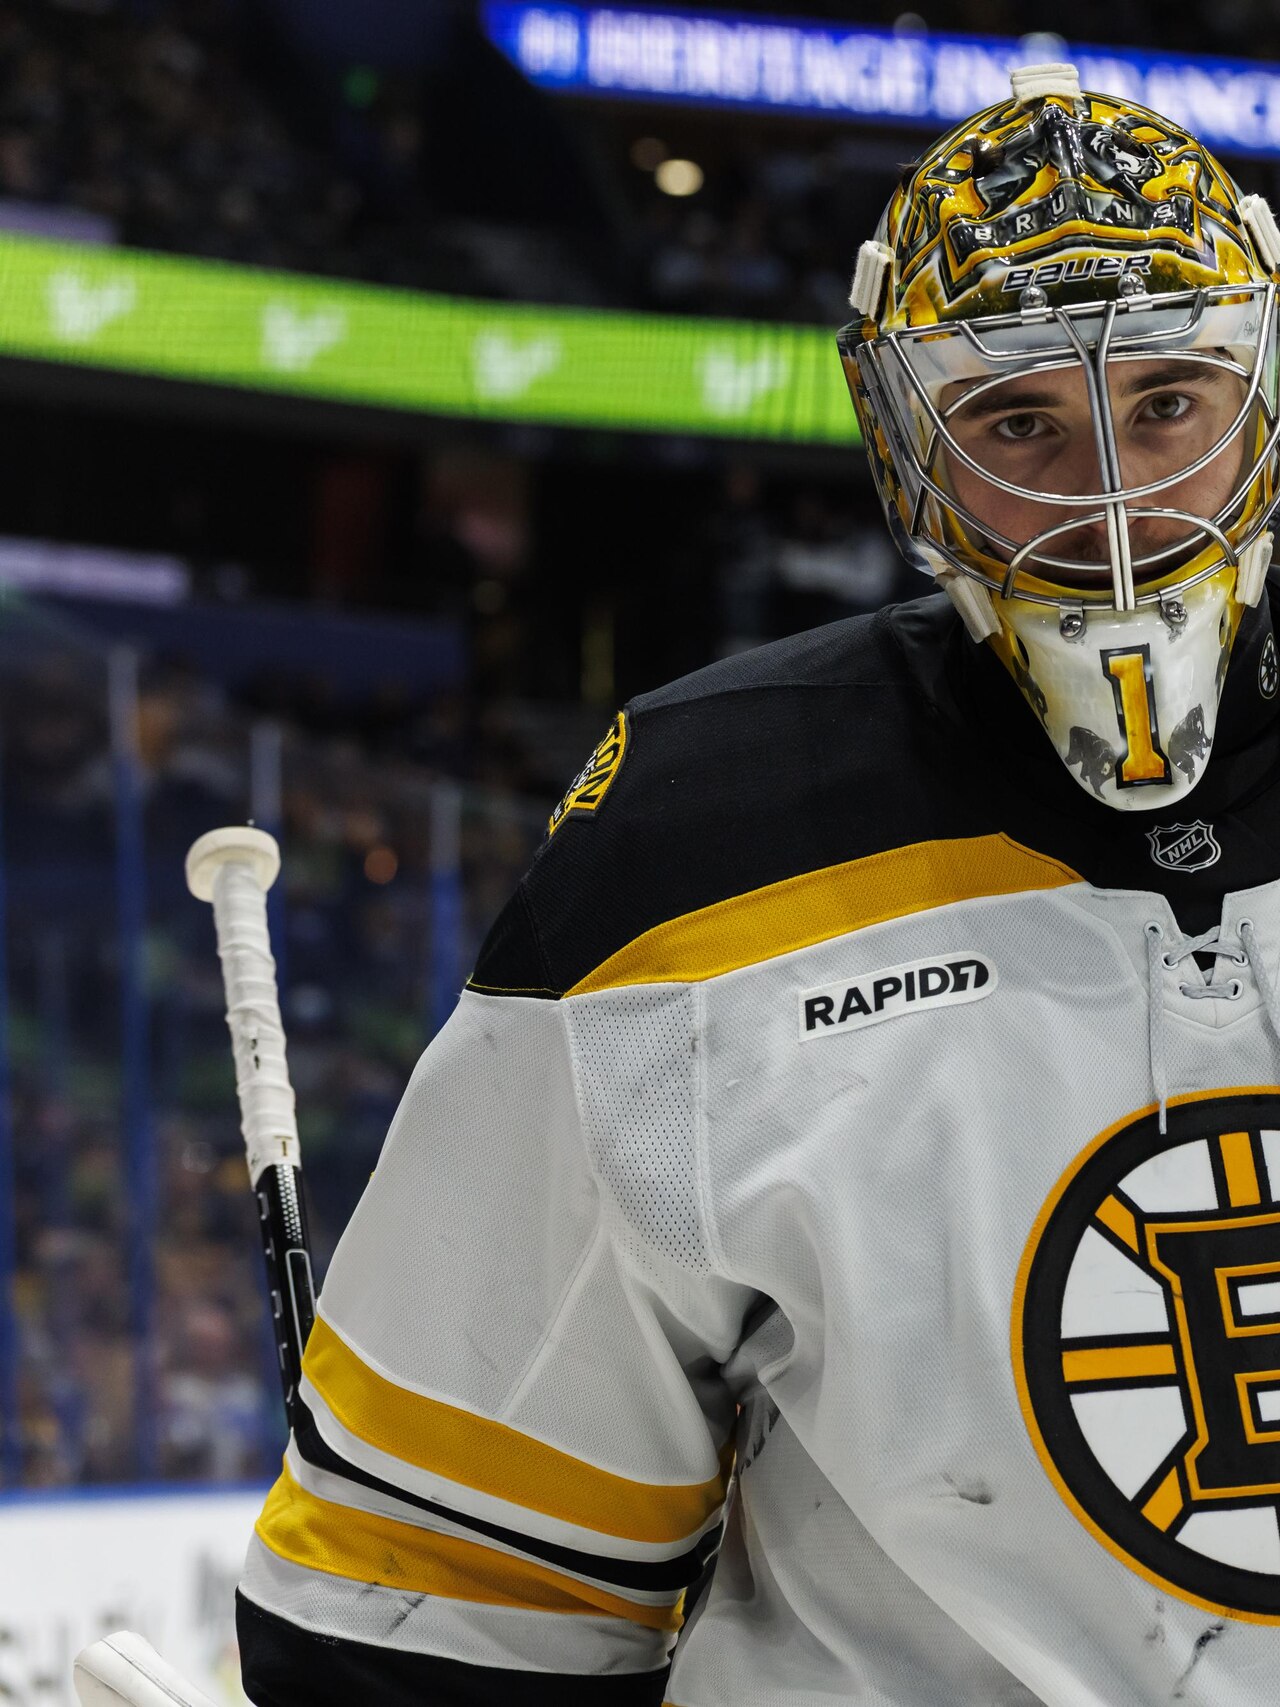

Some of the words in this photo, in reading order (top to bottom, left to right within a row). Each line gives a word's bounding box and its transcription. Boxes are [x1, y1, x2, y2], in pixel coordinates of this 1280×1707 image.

[974, 194, 1172, 241] BRUINS
[1002, 255, 1153, 292] BAUER
[1167, 833, 1203, 863] NHL
[804, 959, 989, 1031] RAPID7
